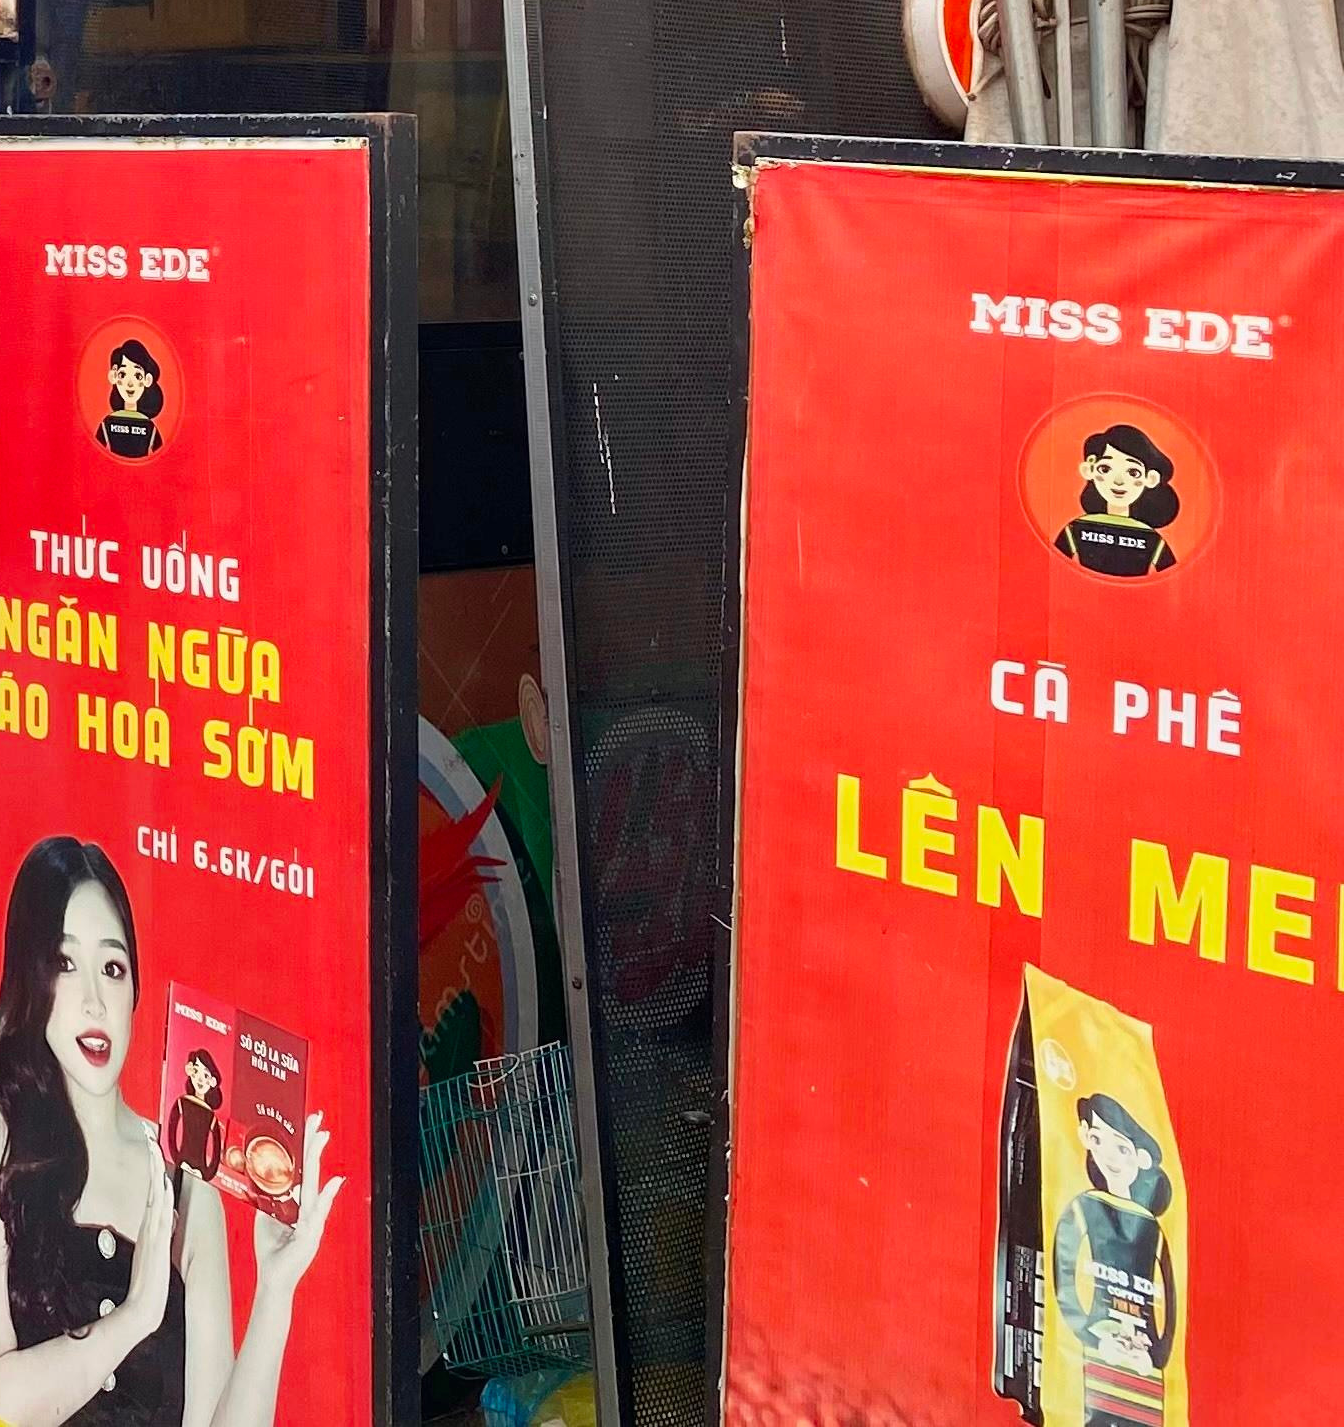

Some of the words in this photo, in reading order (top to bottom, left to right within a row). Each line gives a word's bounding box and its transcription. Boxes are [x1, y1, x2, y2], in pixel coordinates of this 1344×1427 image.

[45, 244, 127, 280] MISS
[139, 246, 210, 283] EDE
[969, 291, 1122, 347] MISS
[1143, 306, 1274, 360] EDE
[30, 514, 120, 584] THỨC
[141, 530, 240, 602] UỐNG
[1081, 530, 1115, 545] MISS
[1118, 536, 1146, 549] EDE
[1112, 682, 1242, 757] PHÊ
[136, 824, 178, 865] CHỈ
[835, 771, 1046, 919] LÊN
[1128, 837, 1344, 993] ME
[254, 1040, 267, 1058] CÔ
[268, 1047, 280, 1065] LA
